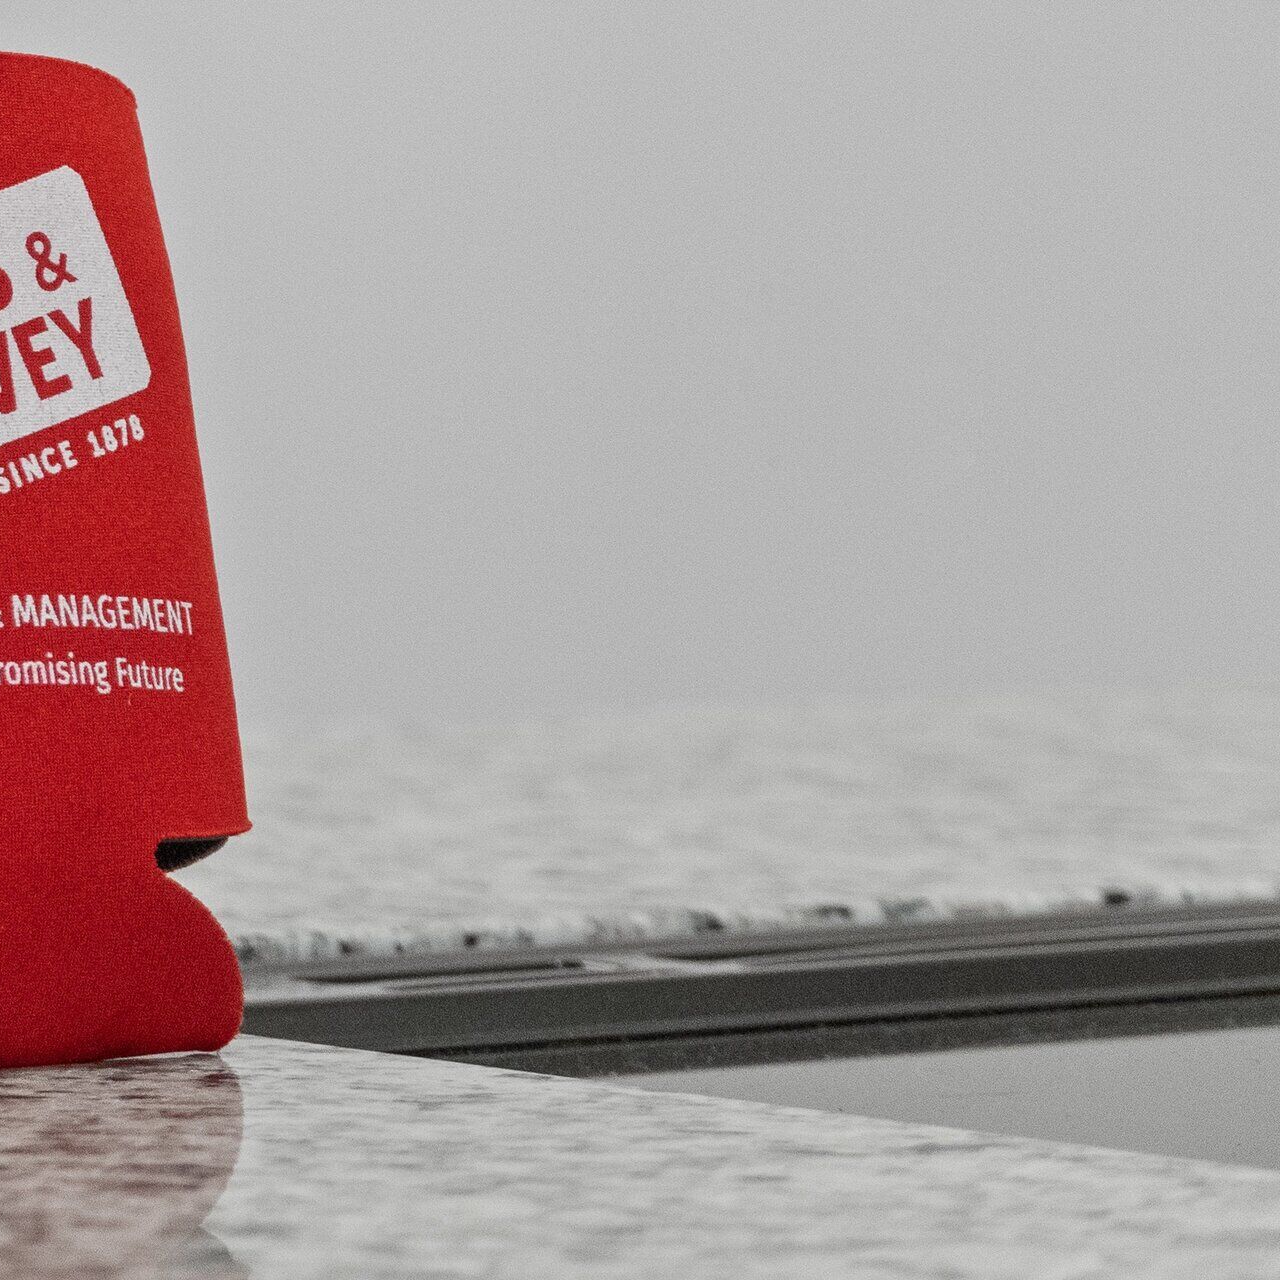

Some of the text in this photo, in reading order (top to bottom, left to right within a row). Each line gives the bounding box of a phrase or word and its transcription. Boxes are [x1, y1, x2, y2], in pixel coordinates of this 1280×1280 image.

[25, 231, 79, 292] &
[86, 414, 145, 459] 1878
[11, 593, 193, 636] MANAGEMENT
[114, 657, 185, 693] Future
